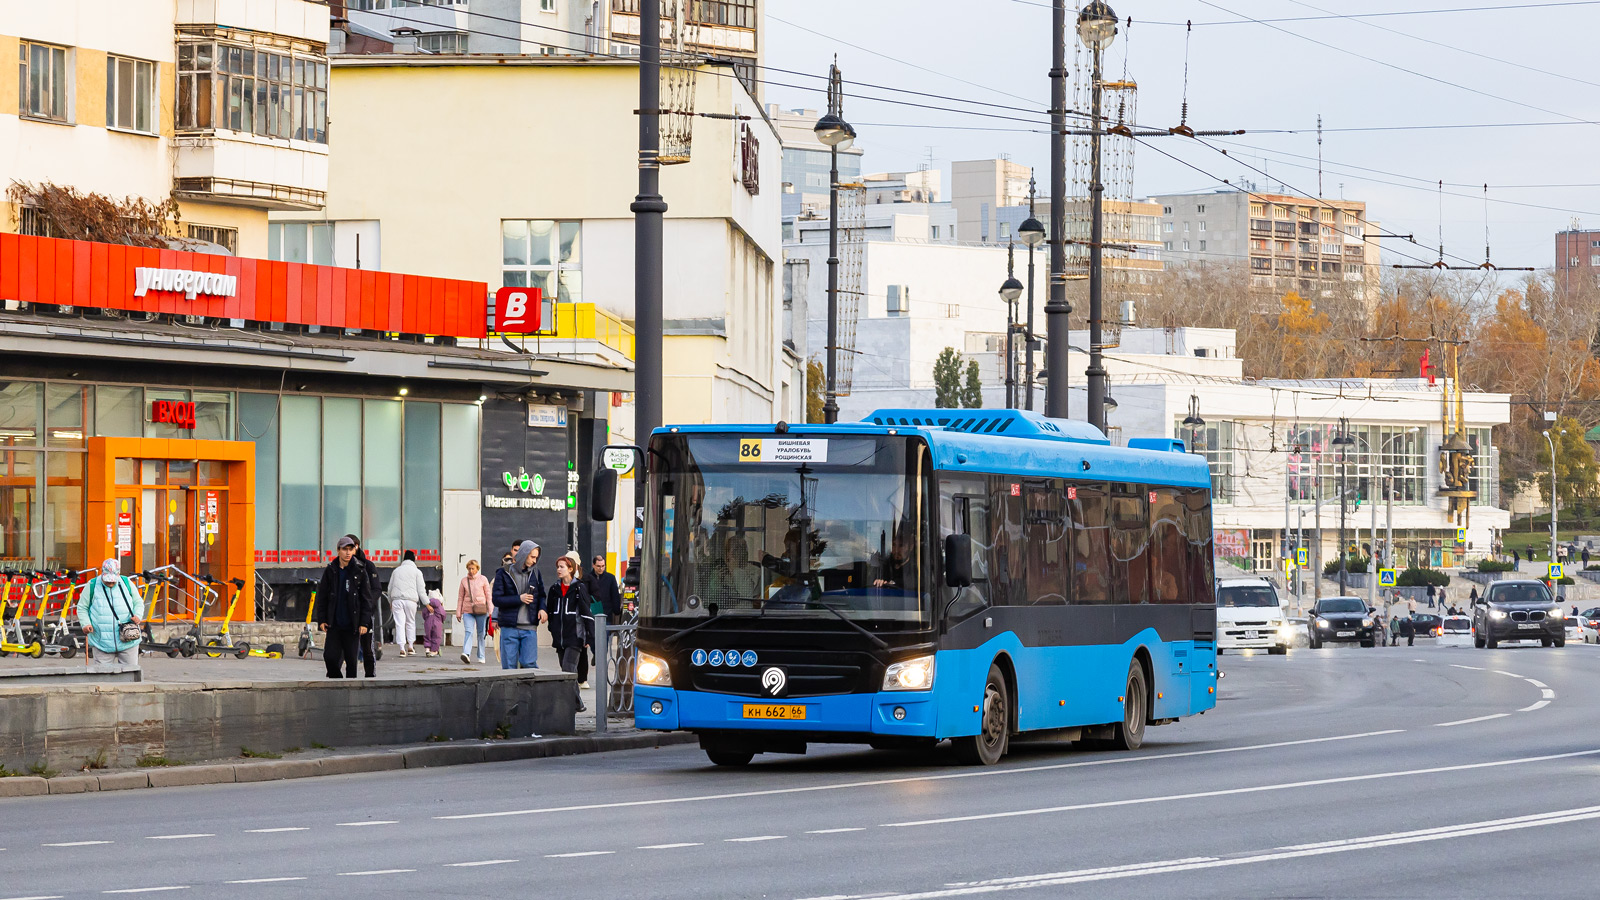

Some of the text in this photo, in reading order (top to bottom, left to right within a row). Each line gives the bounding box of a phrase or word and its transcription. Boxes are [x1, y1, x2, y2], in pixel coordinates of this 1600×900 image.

[134, 267, 237, 300] универсам
[158, 400, 197, 429] ВХОД
[741, 443, 761, 457] 86
[485, 494, 566, 511] Магазин готовой еды
[748, 706, 802, 718] КН 662 66
